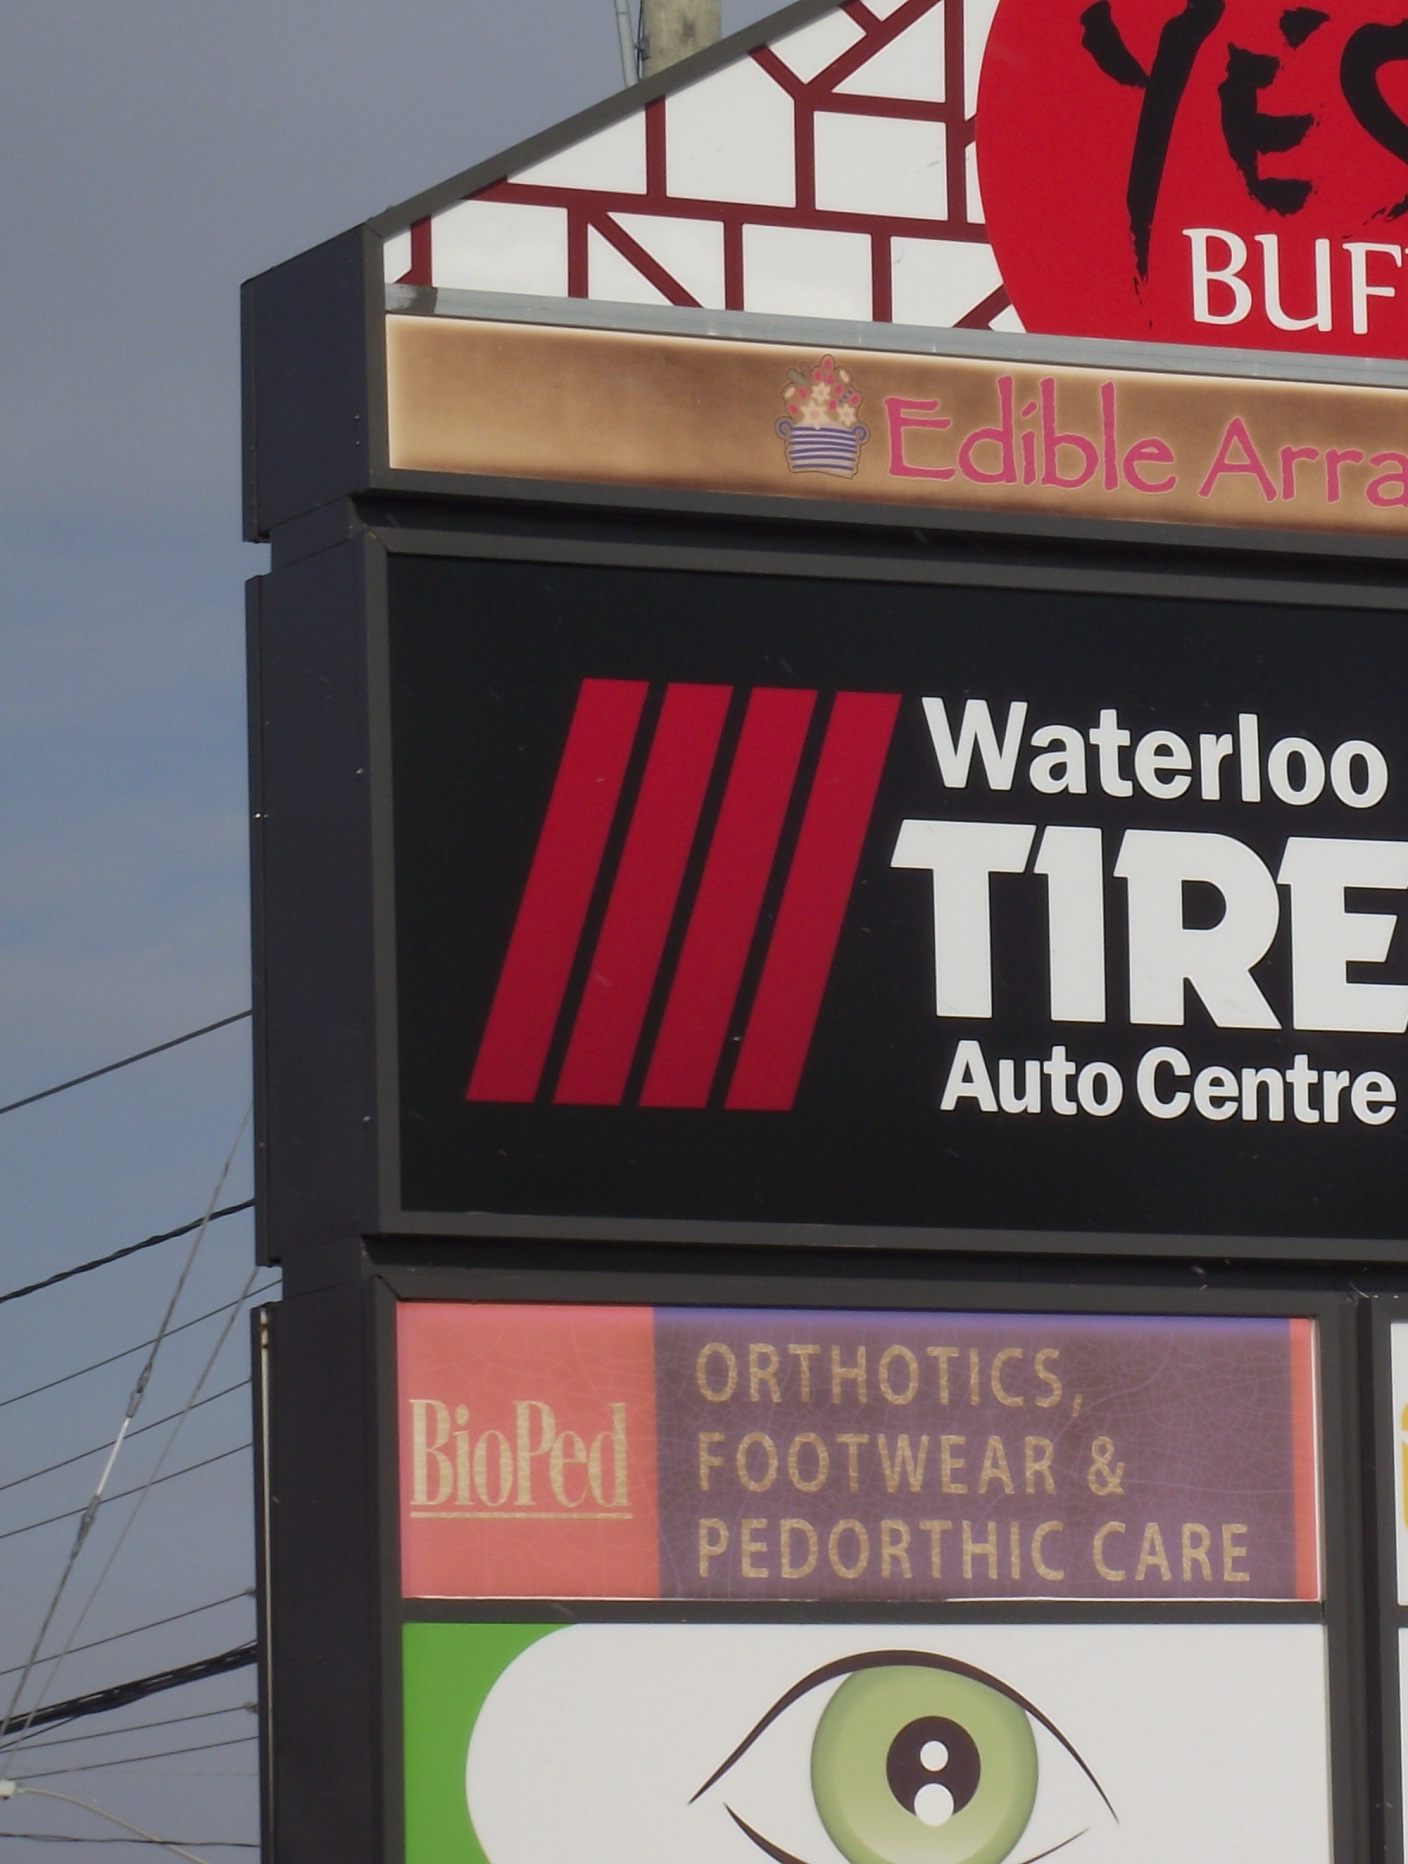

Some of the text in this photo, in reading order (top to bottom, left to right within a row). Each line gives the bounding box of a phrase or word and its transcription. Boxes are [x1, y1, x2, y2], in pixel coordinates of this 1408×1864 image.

[883, 375, 1177, 494] Edible
[921, 696, 1389, 808] Waterloo
[939, 1040, 1397, 1125] Auto Centre
[695, 1341, 1084, 1417] ORTHOTICS,
[409, 1399, 632, 1508] BioPed
[698, 1432, 1126, 1498] FOOTWEAR &
[697, 1517, 1251, 1584] PEDORTHIC CARE
